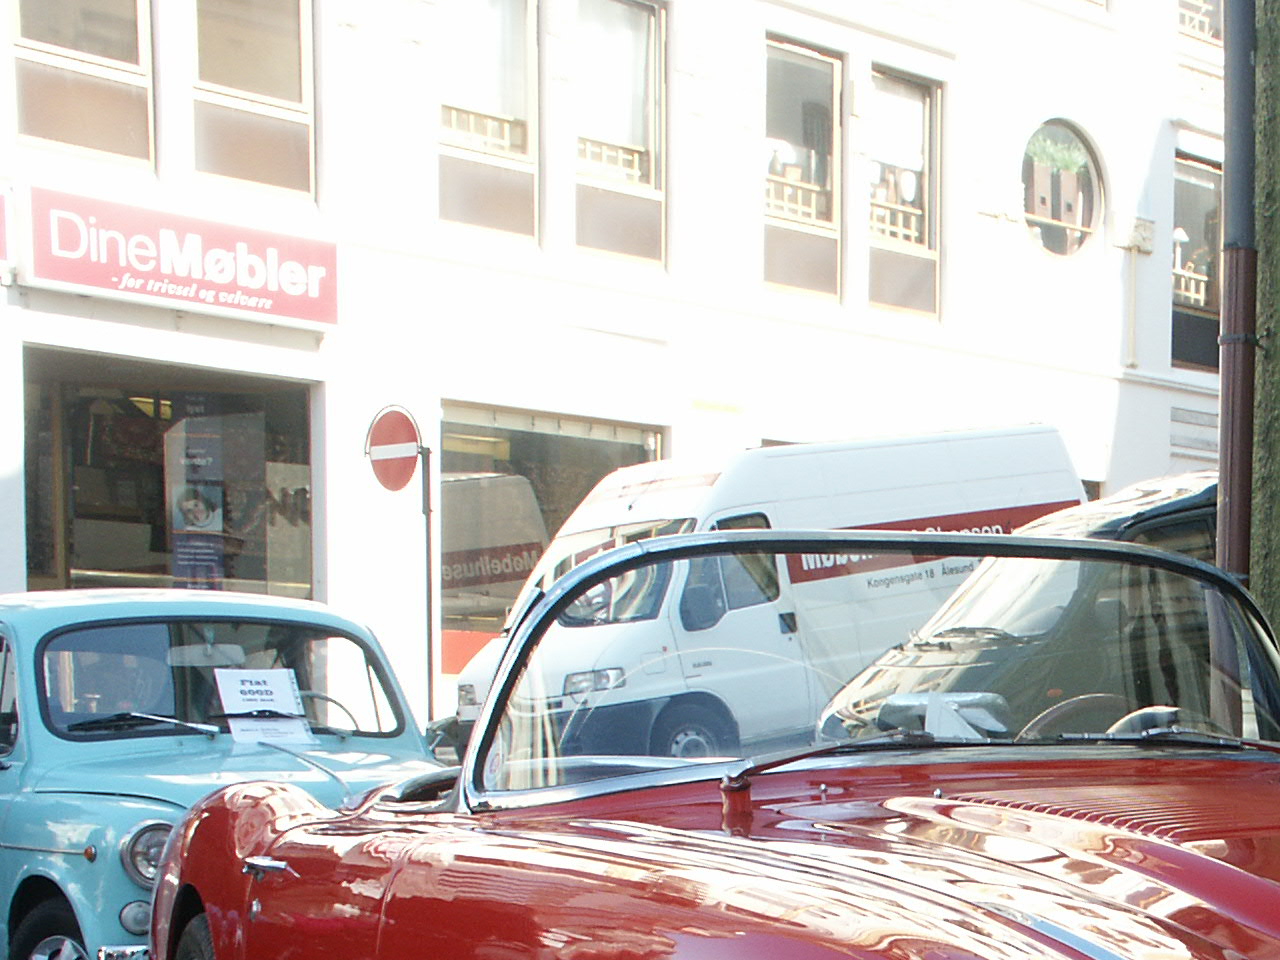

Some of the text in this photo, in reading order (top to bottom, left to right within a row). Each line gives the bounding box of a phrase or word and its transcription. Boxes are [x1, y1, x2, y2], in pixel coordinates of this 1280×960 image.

[50, 208, 326, 298] DineMøbler
[119, 272, 145, 290] for
[199, 288, 217, 303] og
[925, 569, 935, 579] 18
[941, 561, 975, 577] Ålesund
